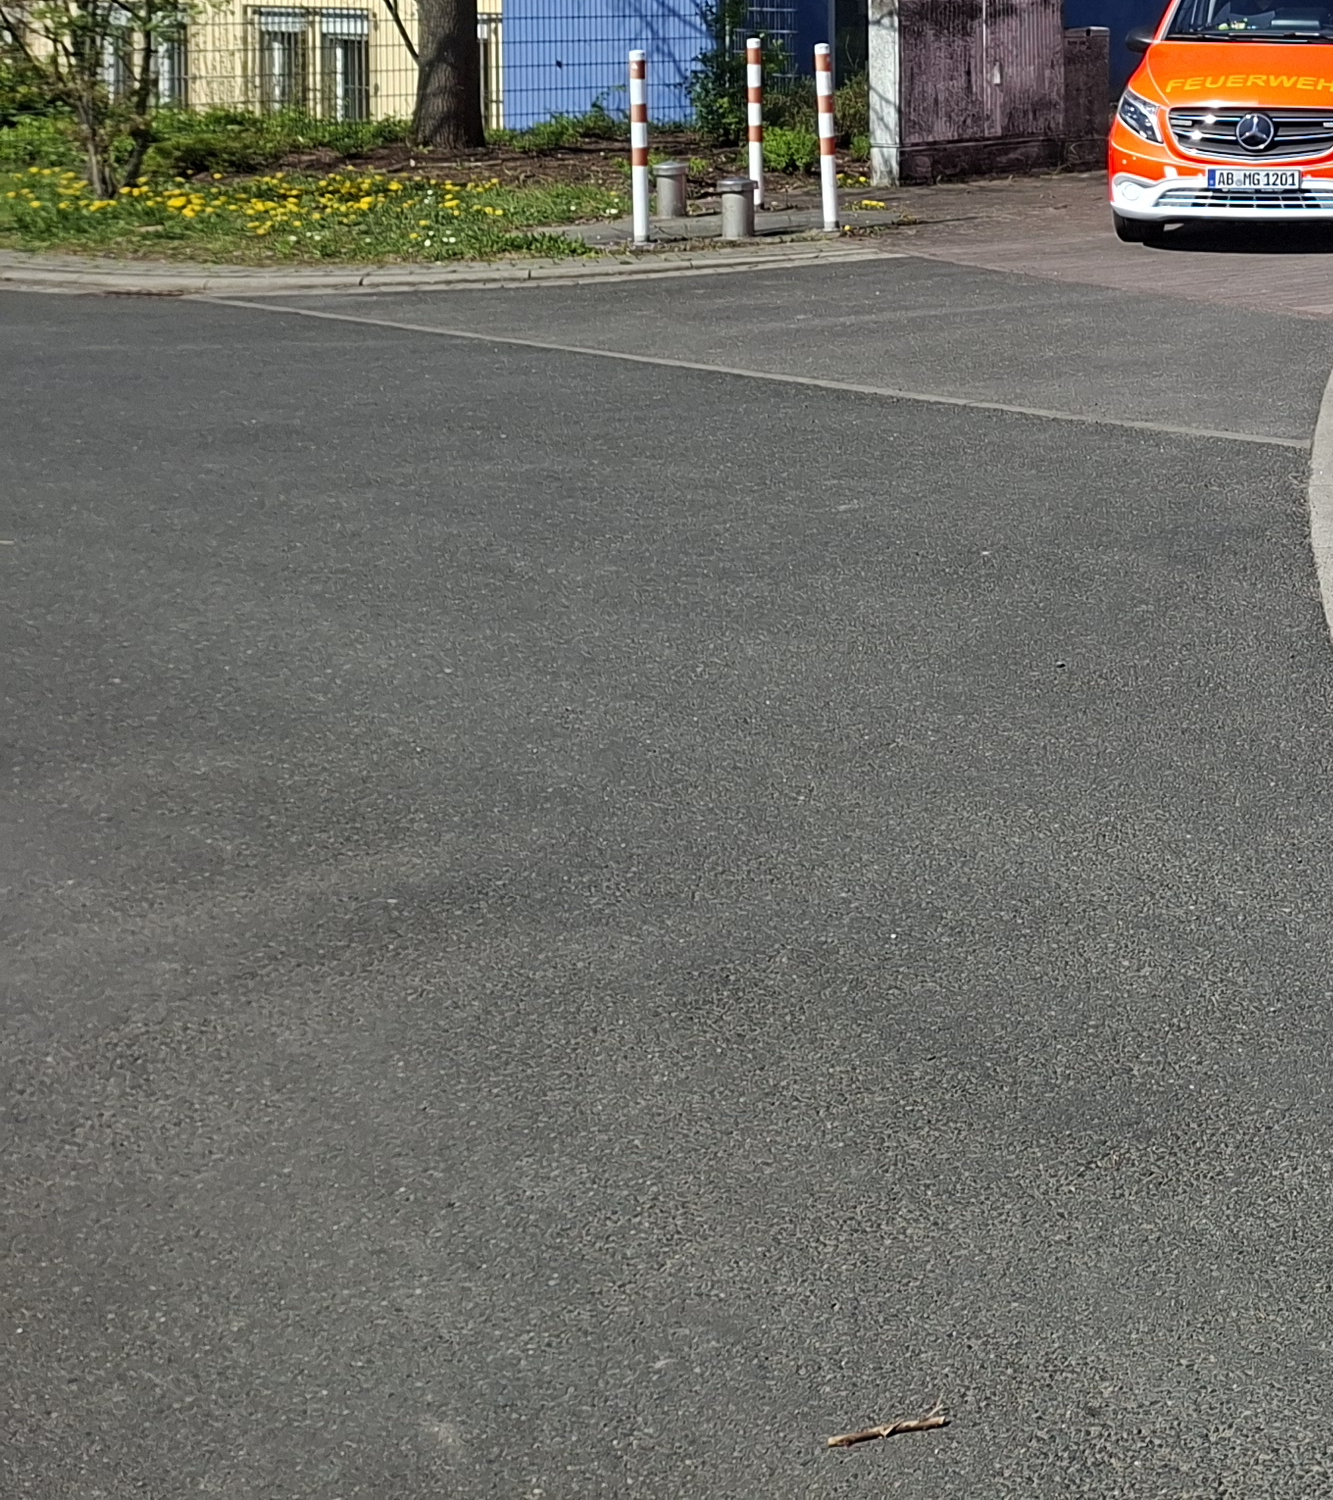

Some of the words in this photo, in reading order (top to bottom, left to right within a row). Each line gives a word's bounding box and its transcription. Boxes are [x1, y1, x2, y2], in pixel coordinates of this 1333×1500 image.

[1217, 172, 1234, 186] AB
[1243, 172, 1260, 186] MG
[1264, 172, 1297, 186] 1201
